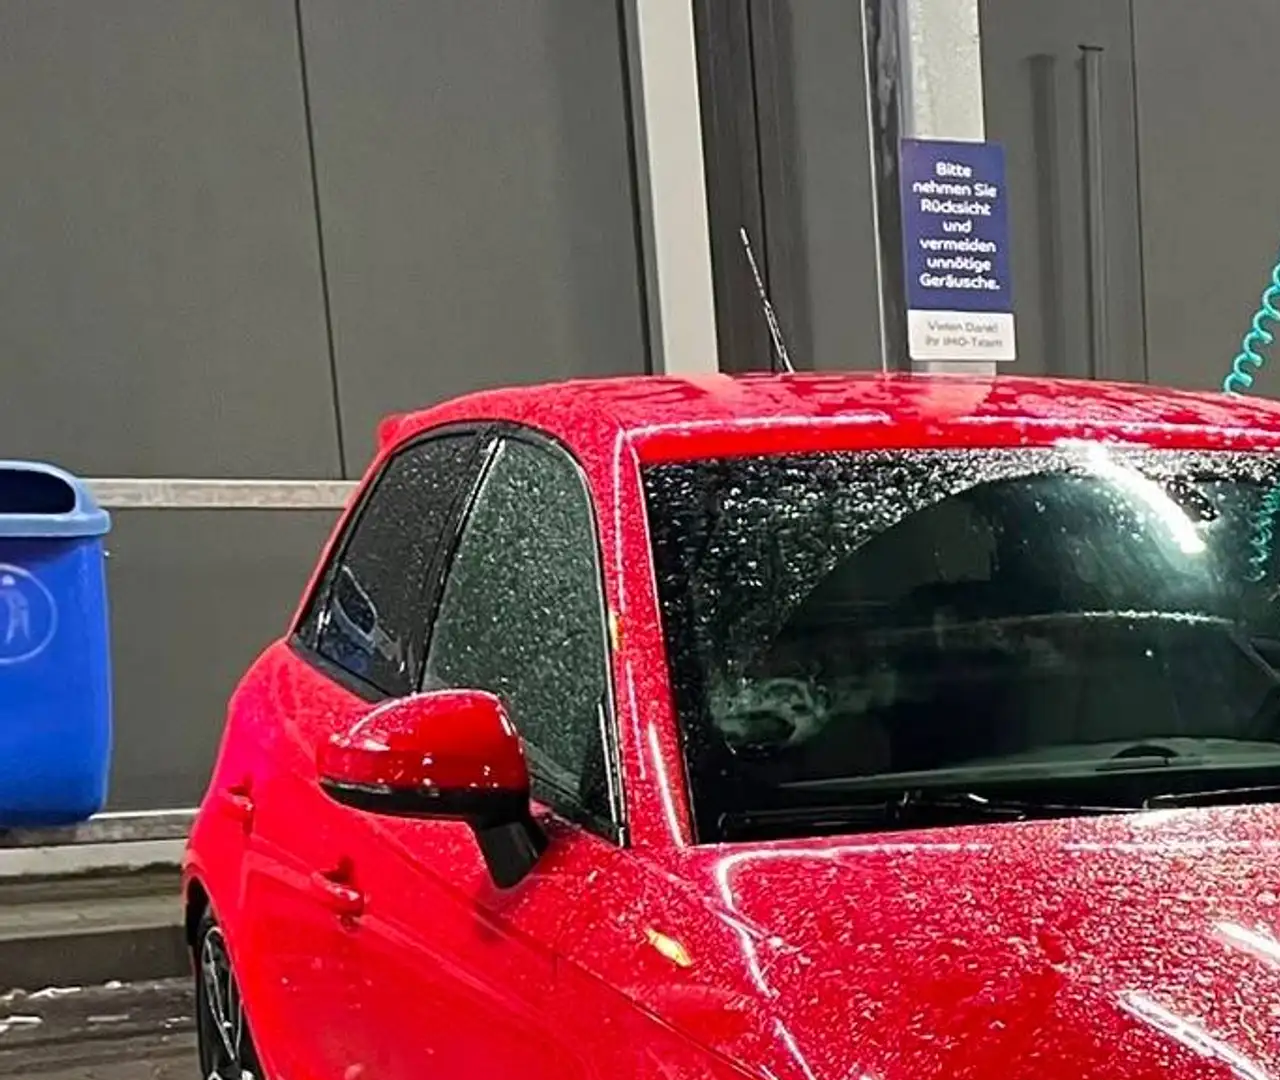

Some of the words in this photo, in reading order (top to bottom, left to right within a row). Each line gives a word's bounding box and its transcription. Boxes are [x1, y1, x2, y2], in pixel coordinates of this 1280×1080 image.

[936, 161, 972, 177] Bitte
[913, 181, 971, 197] nehmen
[974, 184, 997, 199] Sie
[921, 199, 991, 216] Rücksicht
[943, 219, 972, 233] und
[919, 238, 996, 253] vermeiden
[927, 256, 992, 273] unnötige
[919, 273, 1000, 290] Geräusche.
